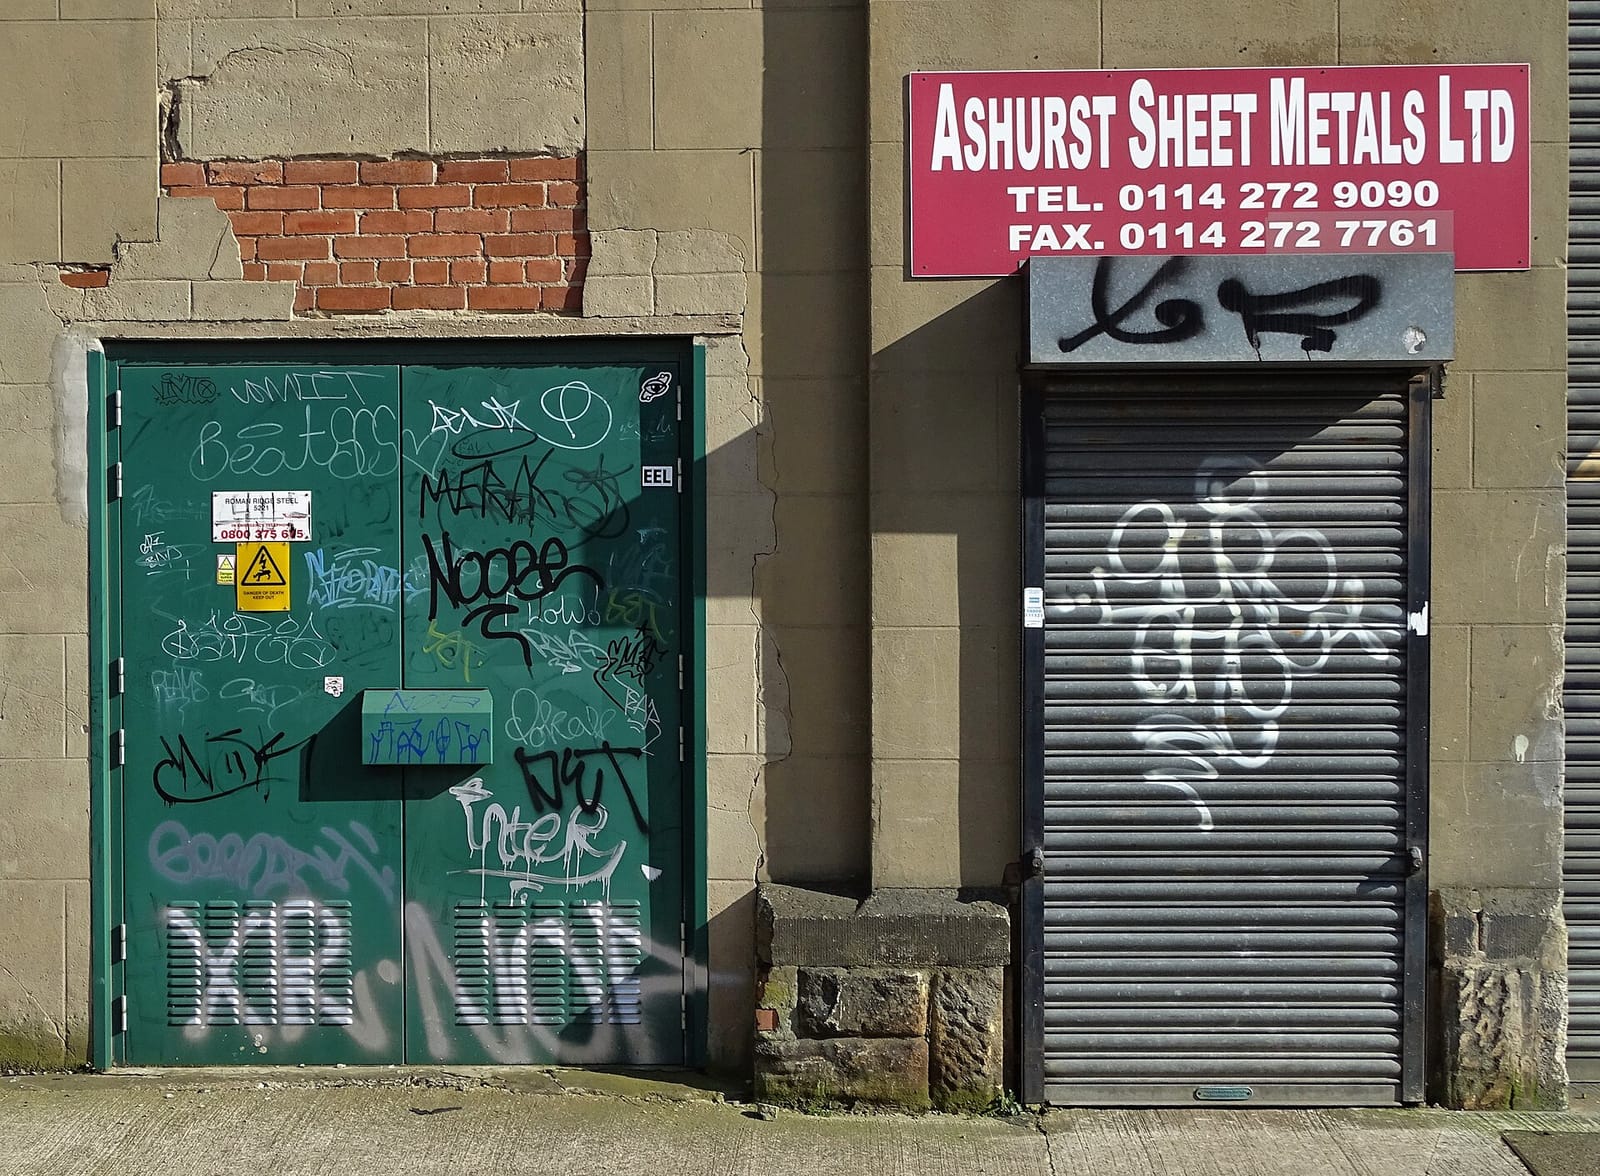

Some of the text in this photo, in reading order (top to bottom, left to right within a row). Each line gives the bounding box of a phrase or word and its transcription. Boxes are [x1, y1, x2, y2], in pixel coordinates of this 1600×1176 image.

[931, 75, 1515, 171] ASHURST SHEET METALS LTD
[1007, 180, 1439, 213] TEL. 0114 272 9090
[1008, 218, 1438, 251] FAX. 0114 272 7761
[643, 469, 671, 484] EEL
[221, 530, 304, 539] 0800 375 65
